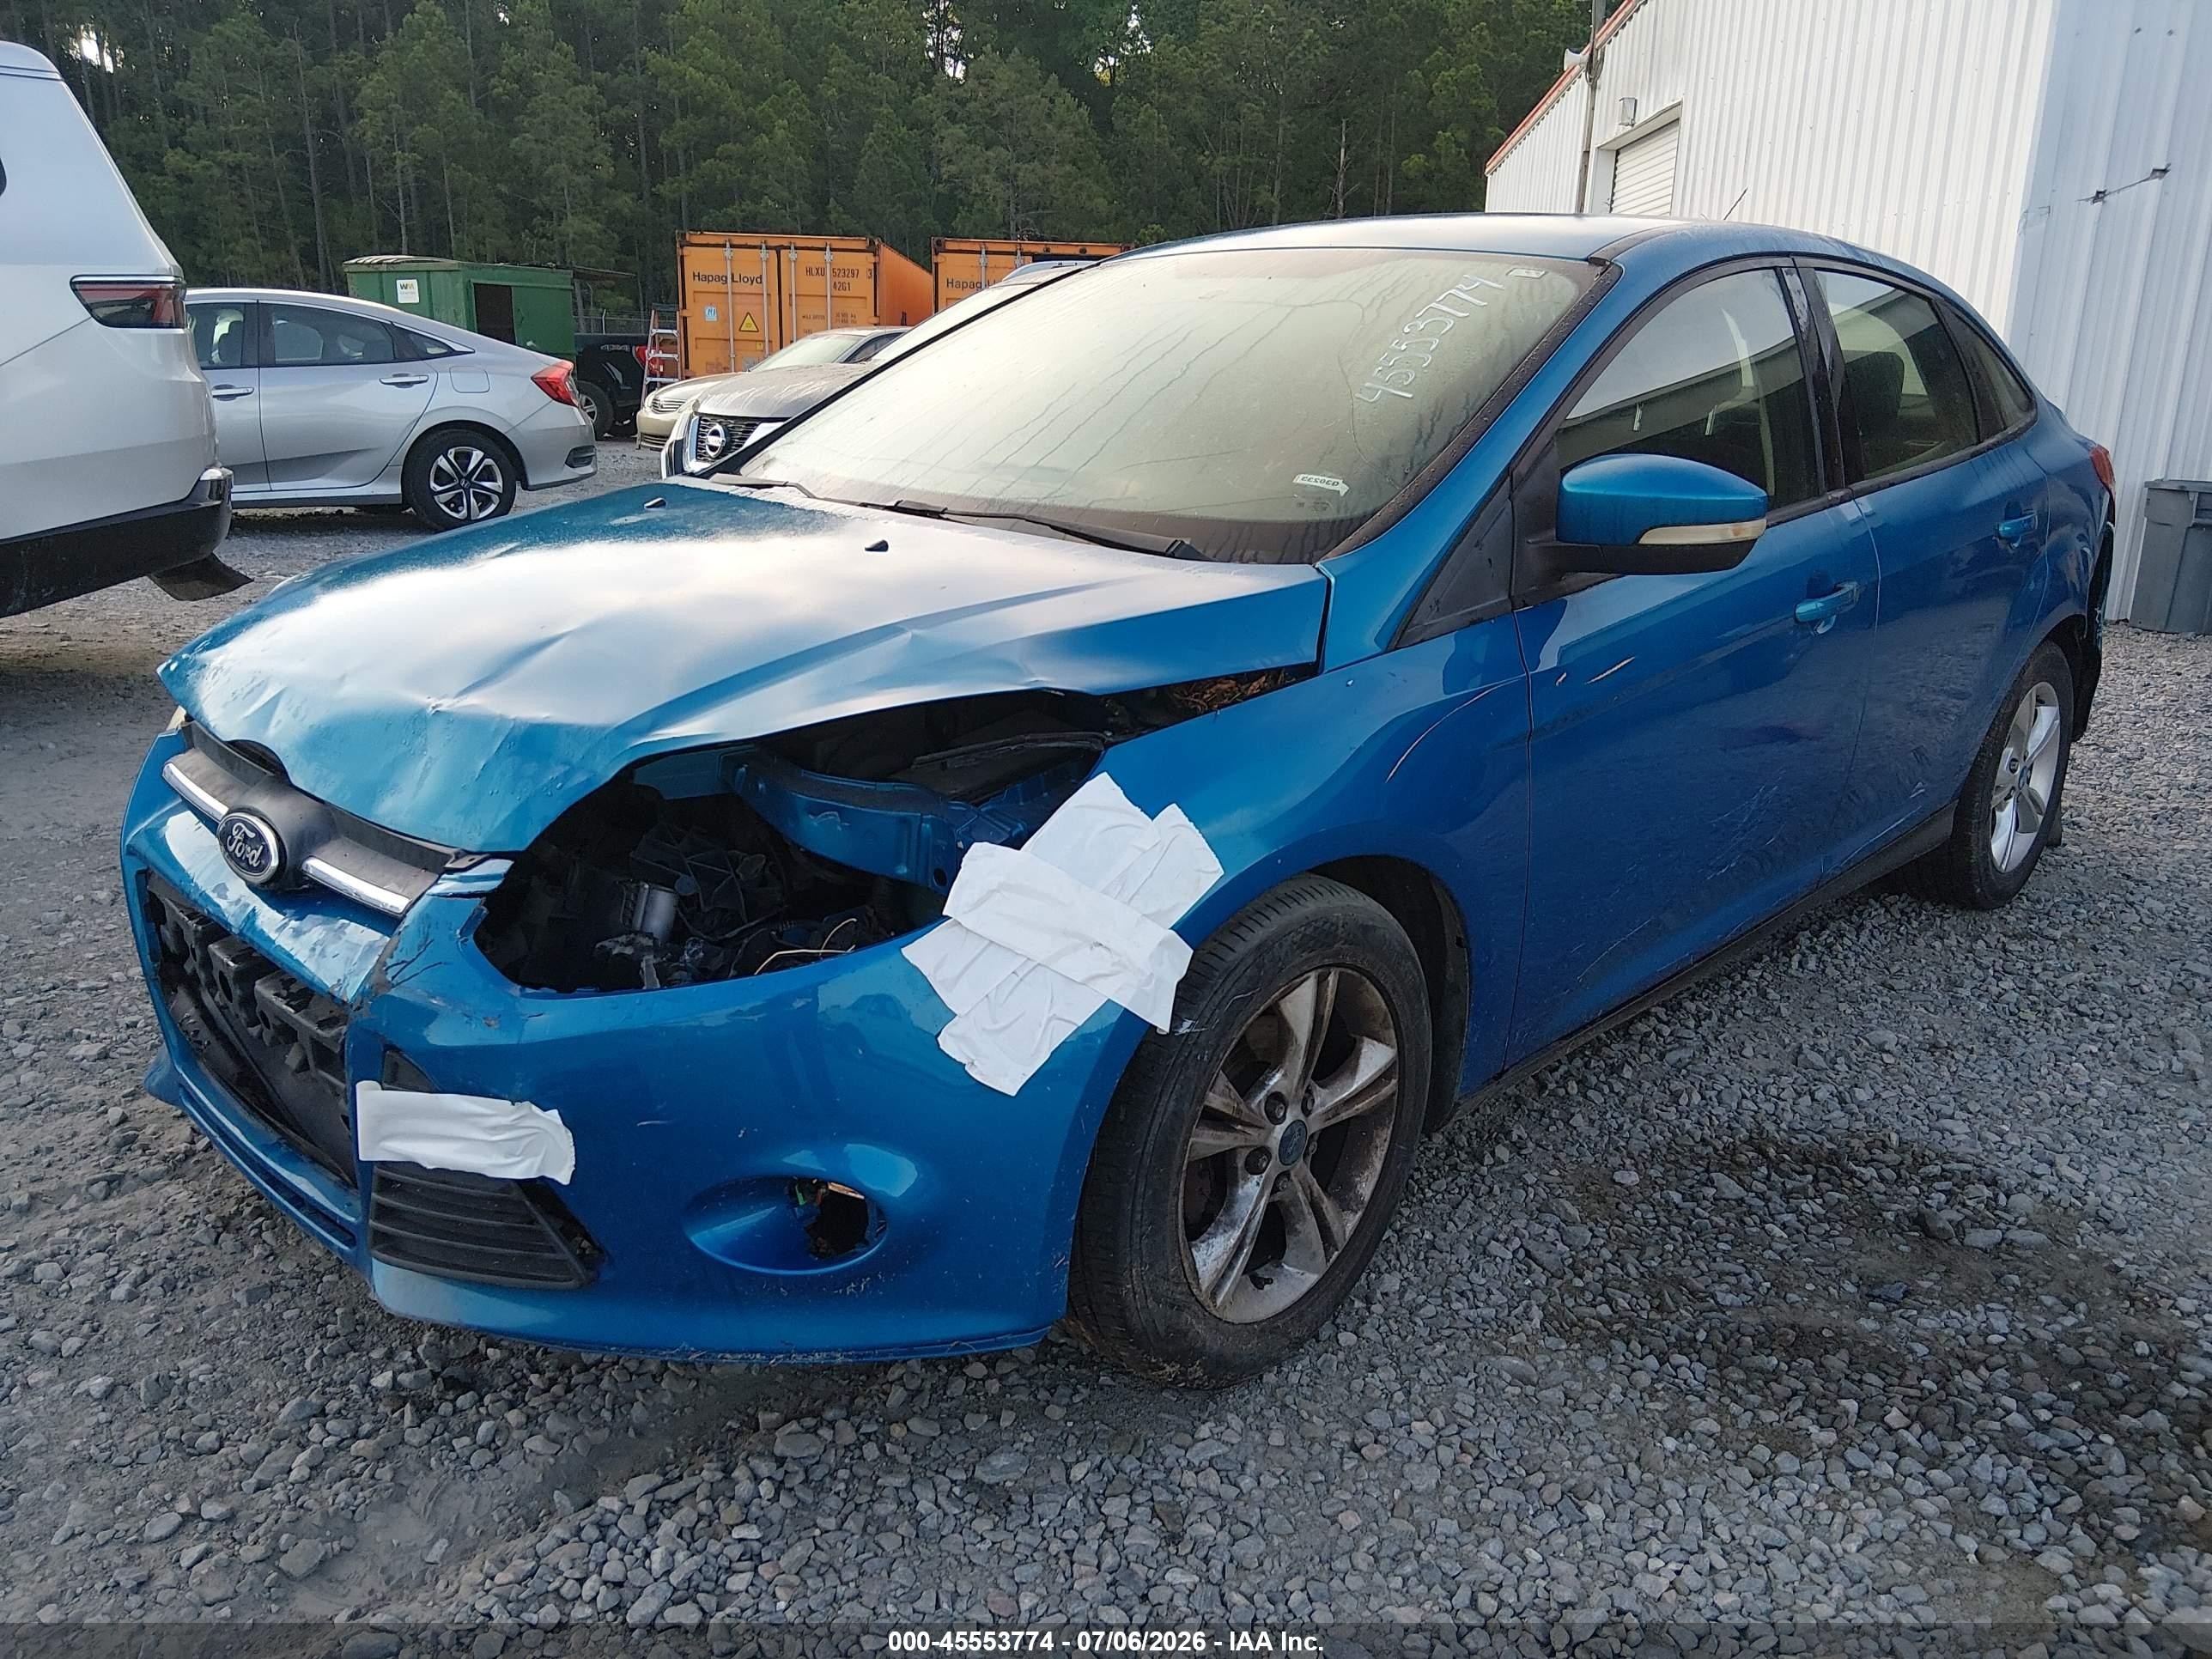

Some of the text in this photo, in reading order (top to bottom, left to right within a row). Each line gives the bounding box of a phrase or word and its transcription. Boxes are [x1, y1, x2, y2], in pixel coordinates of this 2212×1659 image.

[692, 271, 763, 285] Hapag Lloyd
[805, 266, 825, 276] HLXU
[832, 268, 860, 278] 523297
[226, 822, 263, 867] Ford
